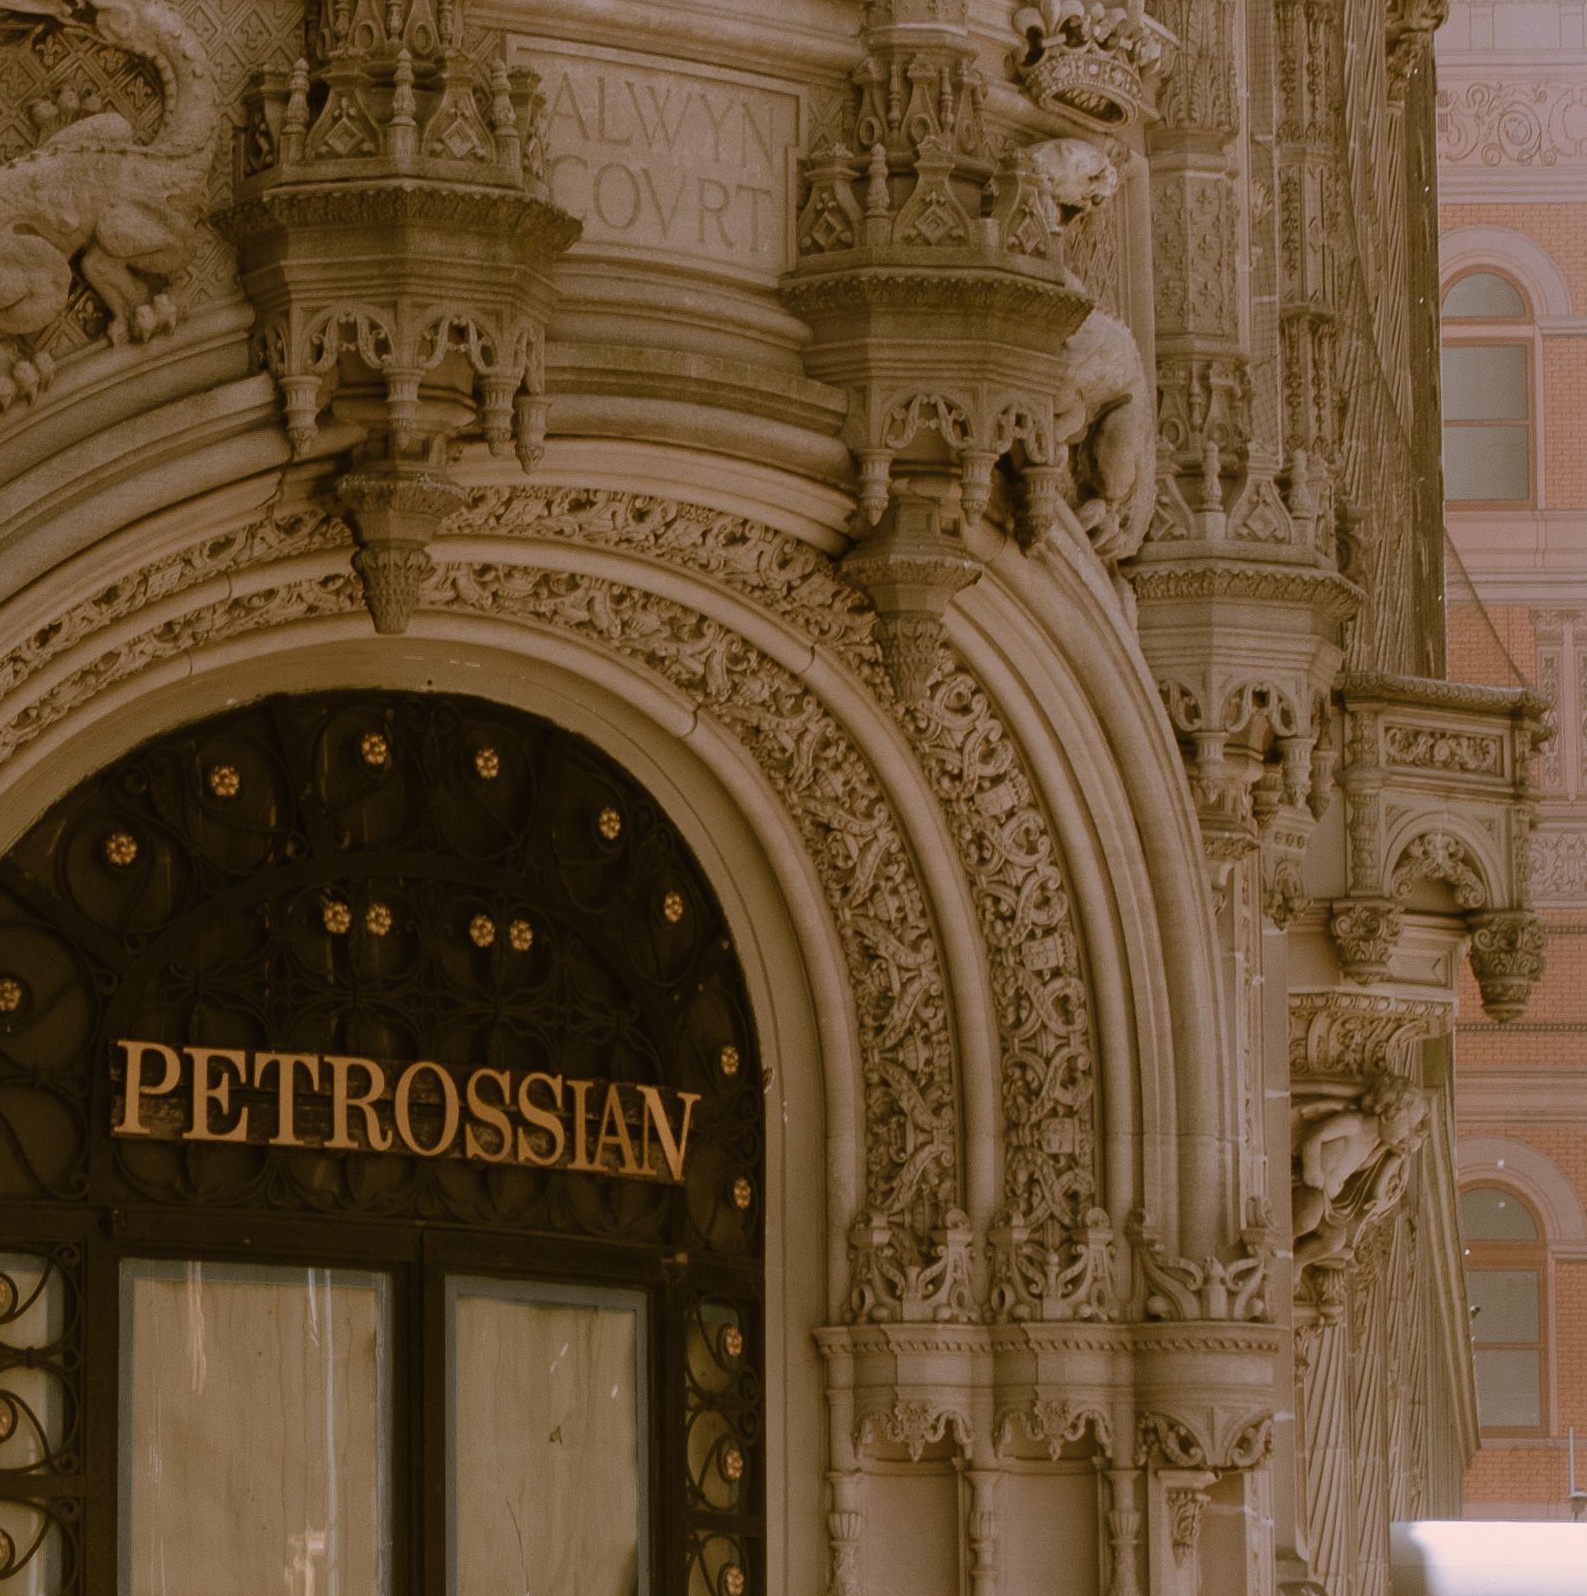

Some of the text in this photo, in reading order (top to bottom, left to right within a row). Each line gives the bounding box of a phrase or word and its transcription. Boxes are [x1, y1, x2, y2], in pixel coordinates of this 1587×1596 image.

[544, 71, 775, 171] ALWYN
[549, 155, 773, 252] COVRT
[114, 1040, 702, 1182] PETROSSIAN
